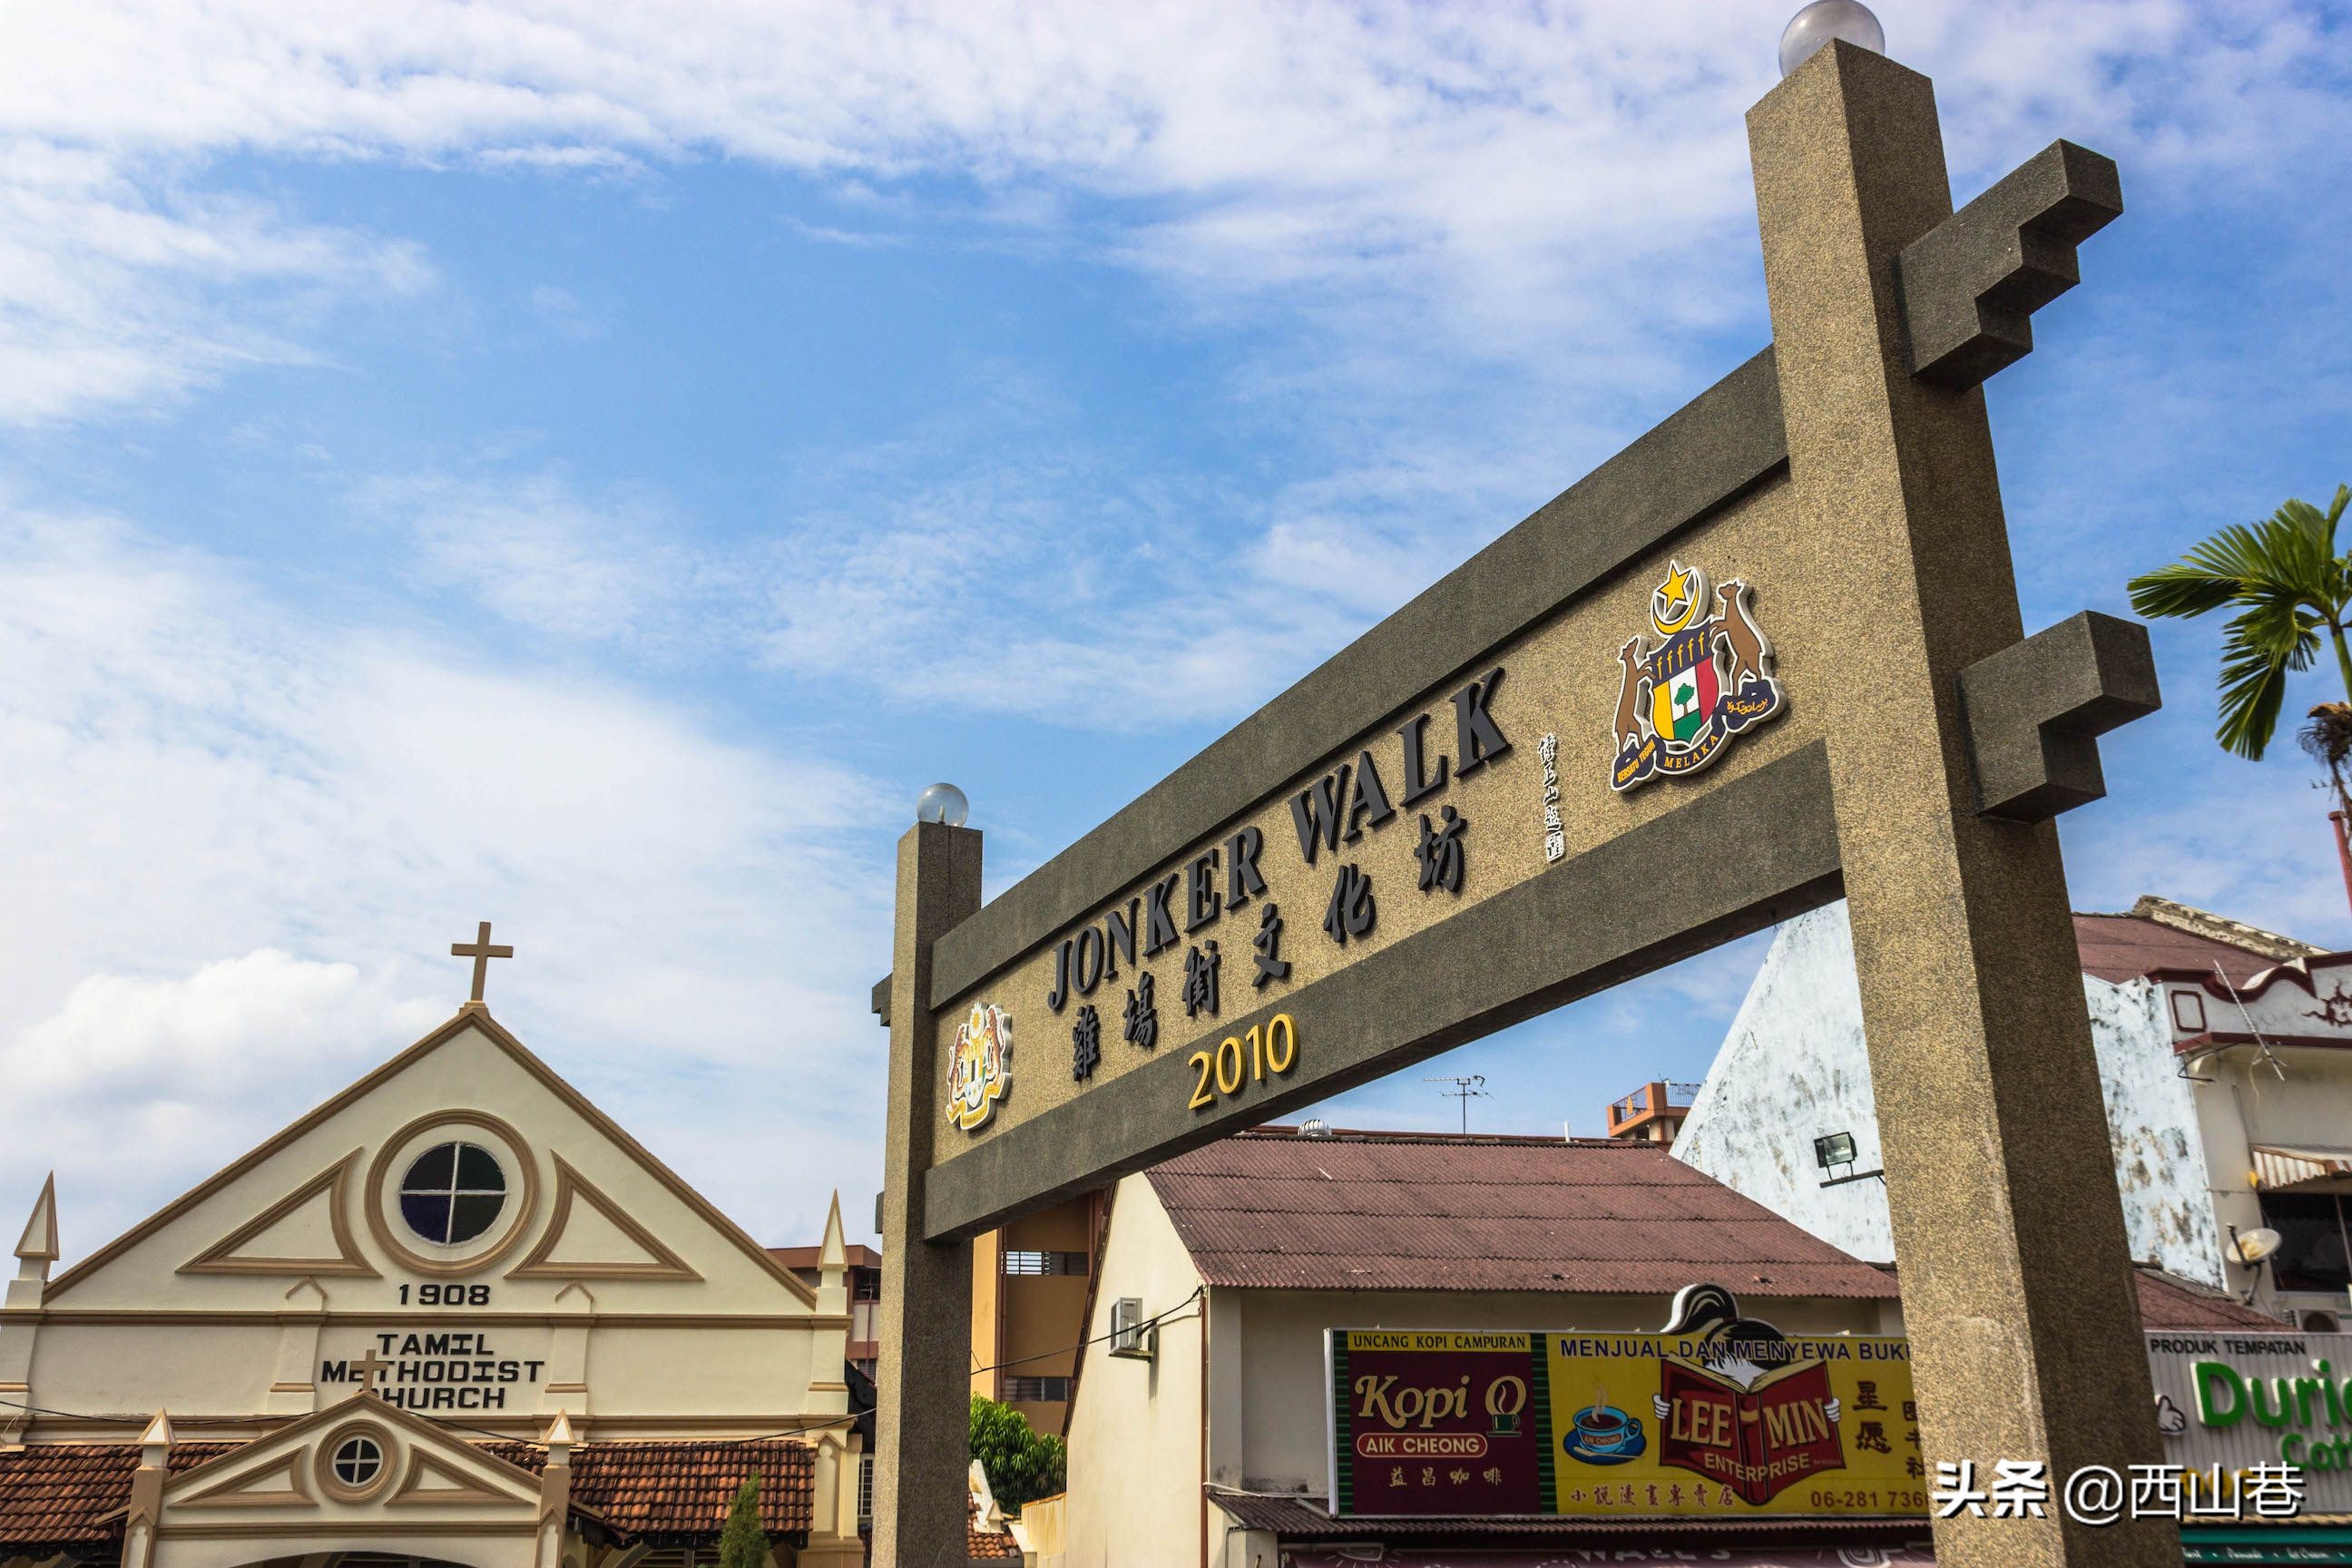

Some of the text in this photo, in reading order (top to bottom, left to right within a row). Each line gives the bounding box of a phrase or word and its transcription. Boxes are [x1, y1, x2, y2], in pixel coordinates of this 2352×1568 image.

[1663, 735, 1720, 769] MELAKA
[1048, 667, 1512, 1011] JONKER WALK
[1188, 1014, 1299, 1111] 2010
[399, 1284, 490, 1306] 1908
[377, 1334, 495, 1355] TAMIL
[1353, 1333, 1525, 1349] UNCANG KOPI CAMPURAN
[1560, 1338, 1670, 1358] MENJUAL
[1679, 1339, 1726, 1359] DAN
[1734, 1340, 1850, 1360] MENYEWA
[2151, 1338, 2306, 1356] PRODUK TEMPATAN
[358, 1387, 505, 1409] HURCH
[1355, 1375, 1468, 1428] Kopi
[1366, 1438, 1480, 1454] AIK CHEONG
[1389, 1465, 1503, 1487] 益昌咖啡
[1704, 1453, 1810, 1482] ENTERPRISE
[1811, 1491, 1928, 1507] 06-281 736
